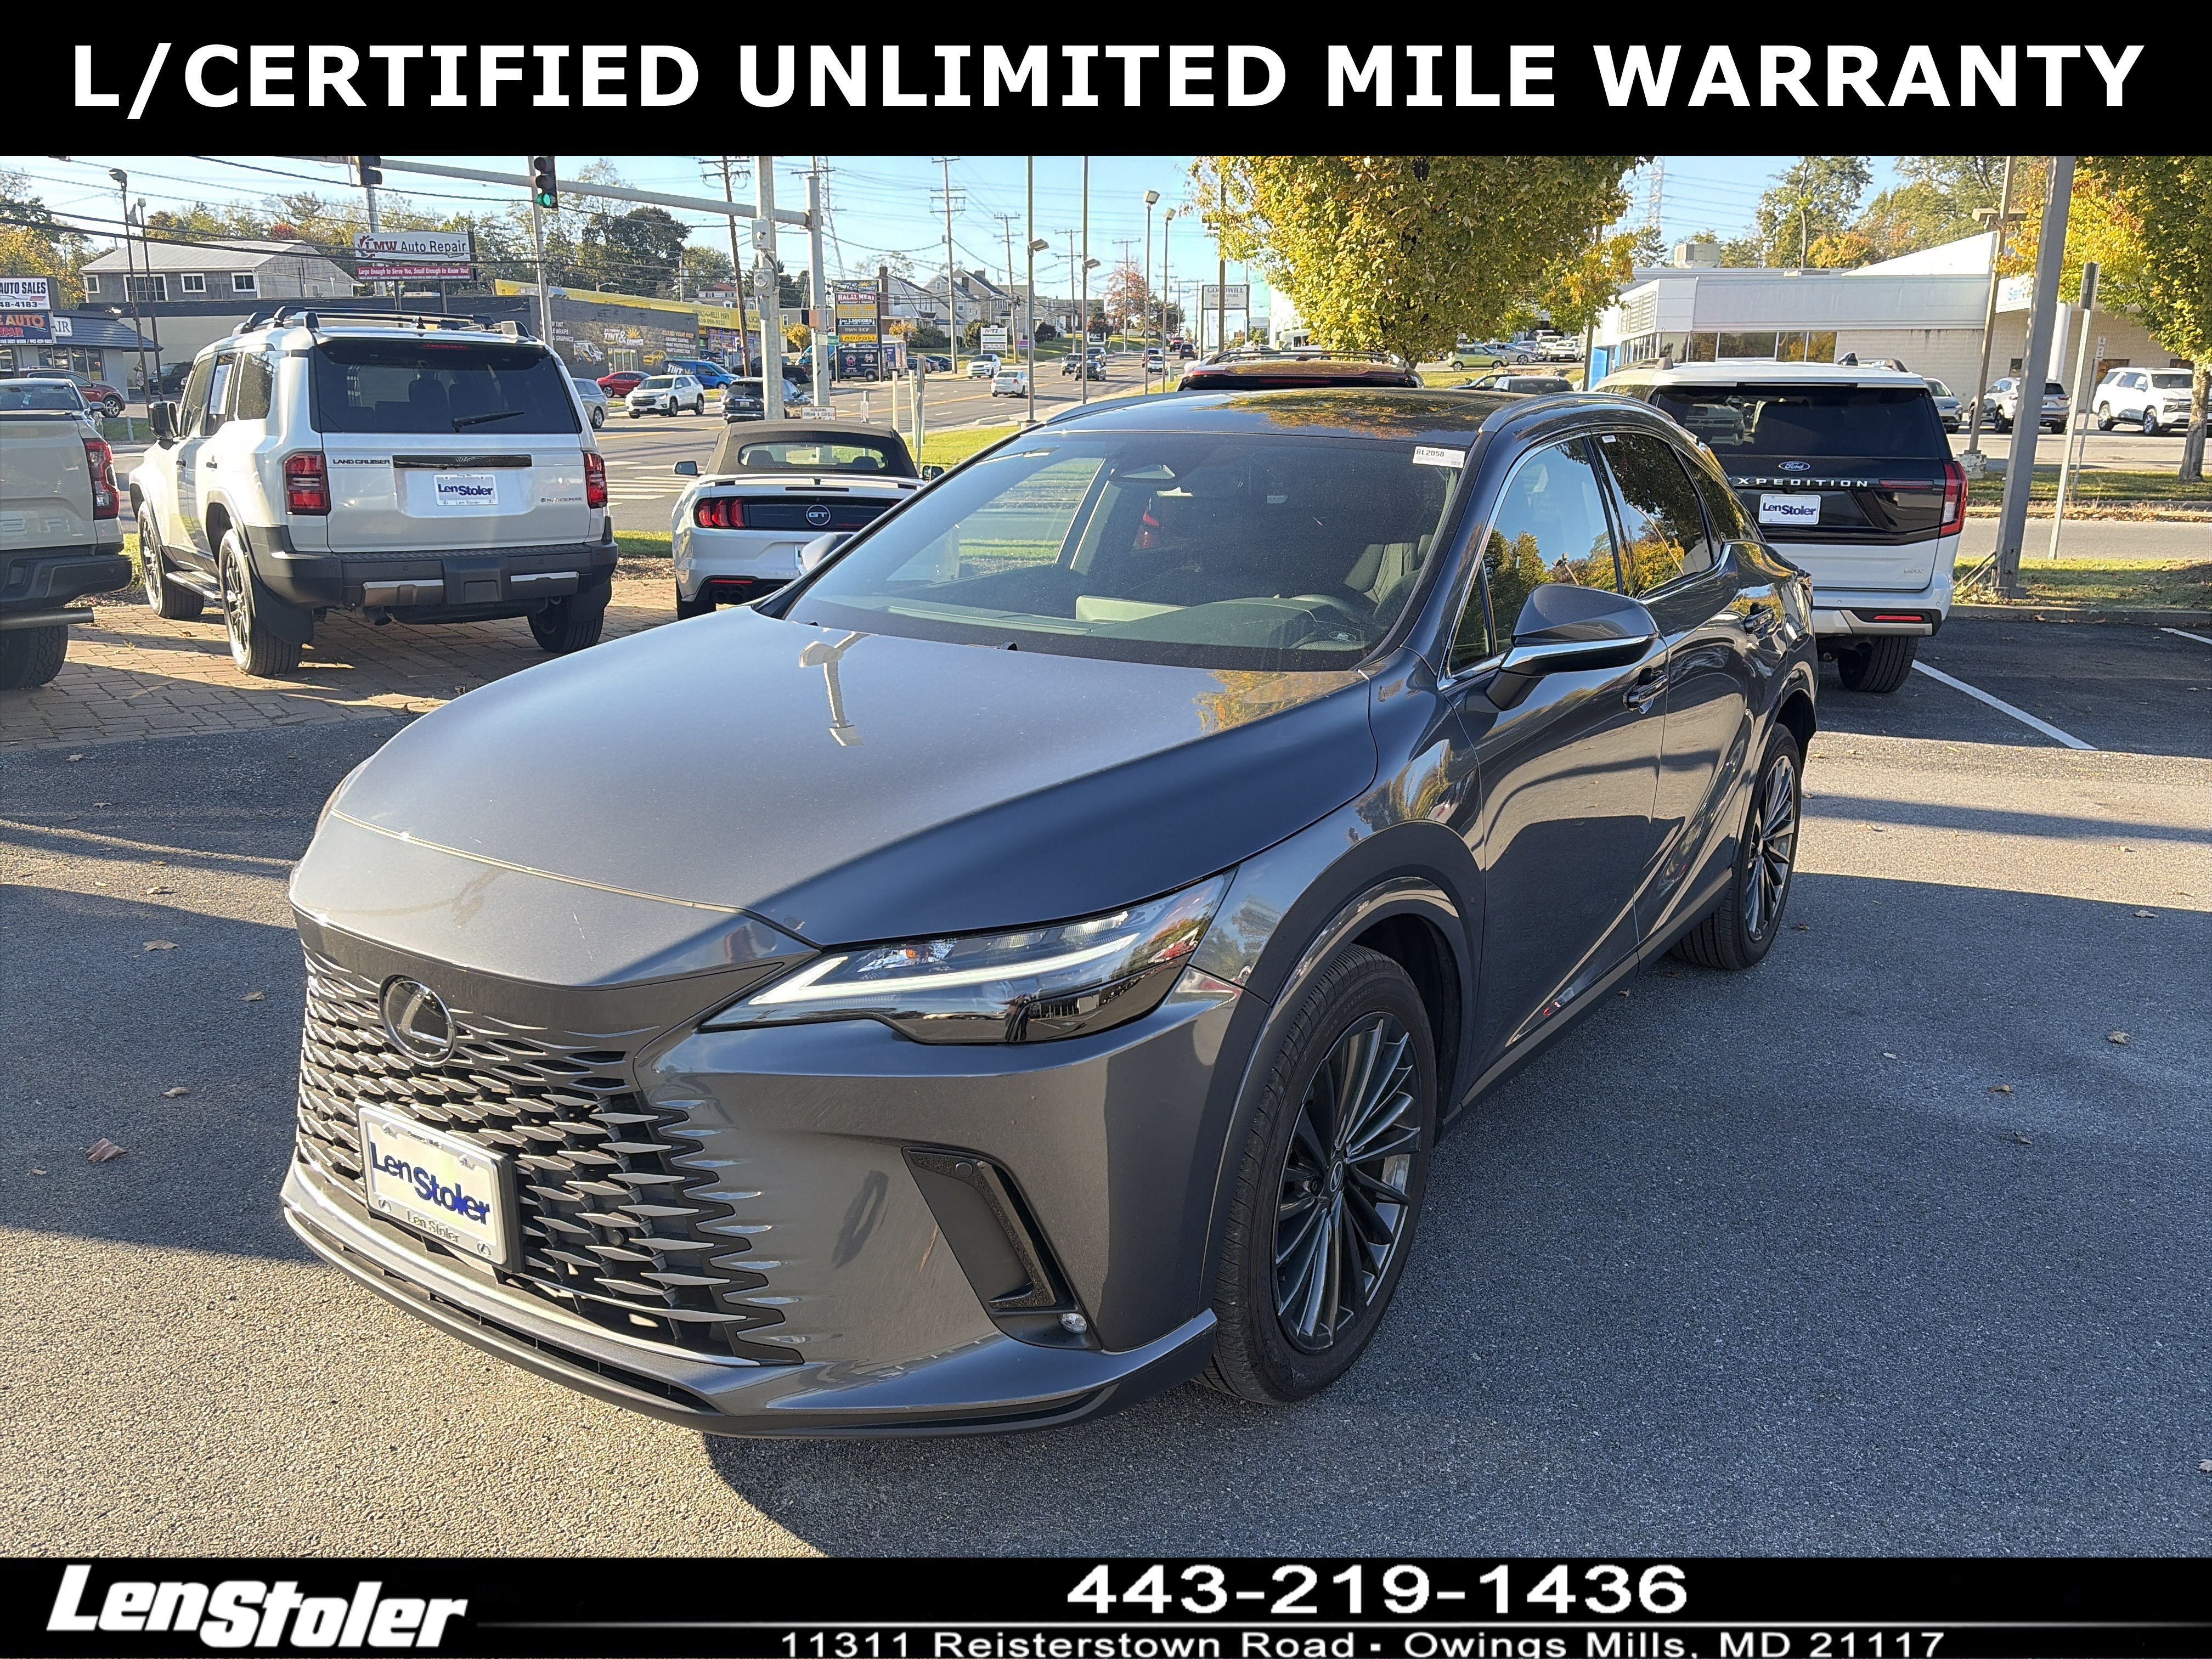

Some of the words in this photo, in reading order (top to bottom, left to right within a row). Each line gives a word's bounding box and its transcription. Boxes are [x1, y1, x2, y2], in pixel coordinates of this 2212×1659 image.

[401, 241, 426, 252] Auto
[430, 240, 466, 254] Repair
[22, 282, 46, 294] SALES
[5, 314, 45, 328] AUTO
[603, 332, 619, 341] TINT
[1728, 477, 1868, 487] XPEDITION
[407, 1209, 426, 1229] Len
[428, 1220, 460, 1243] Stoler
